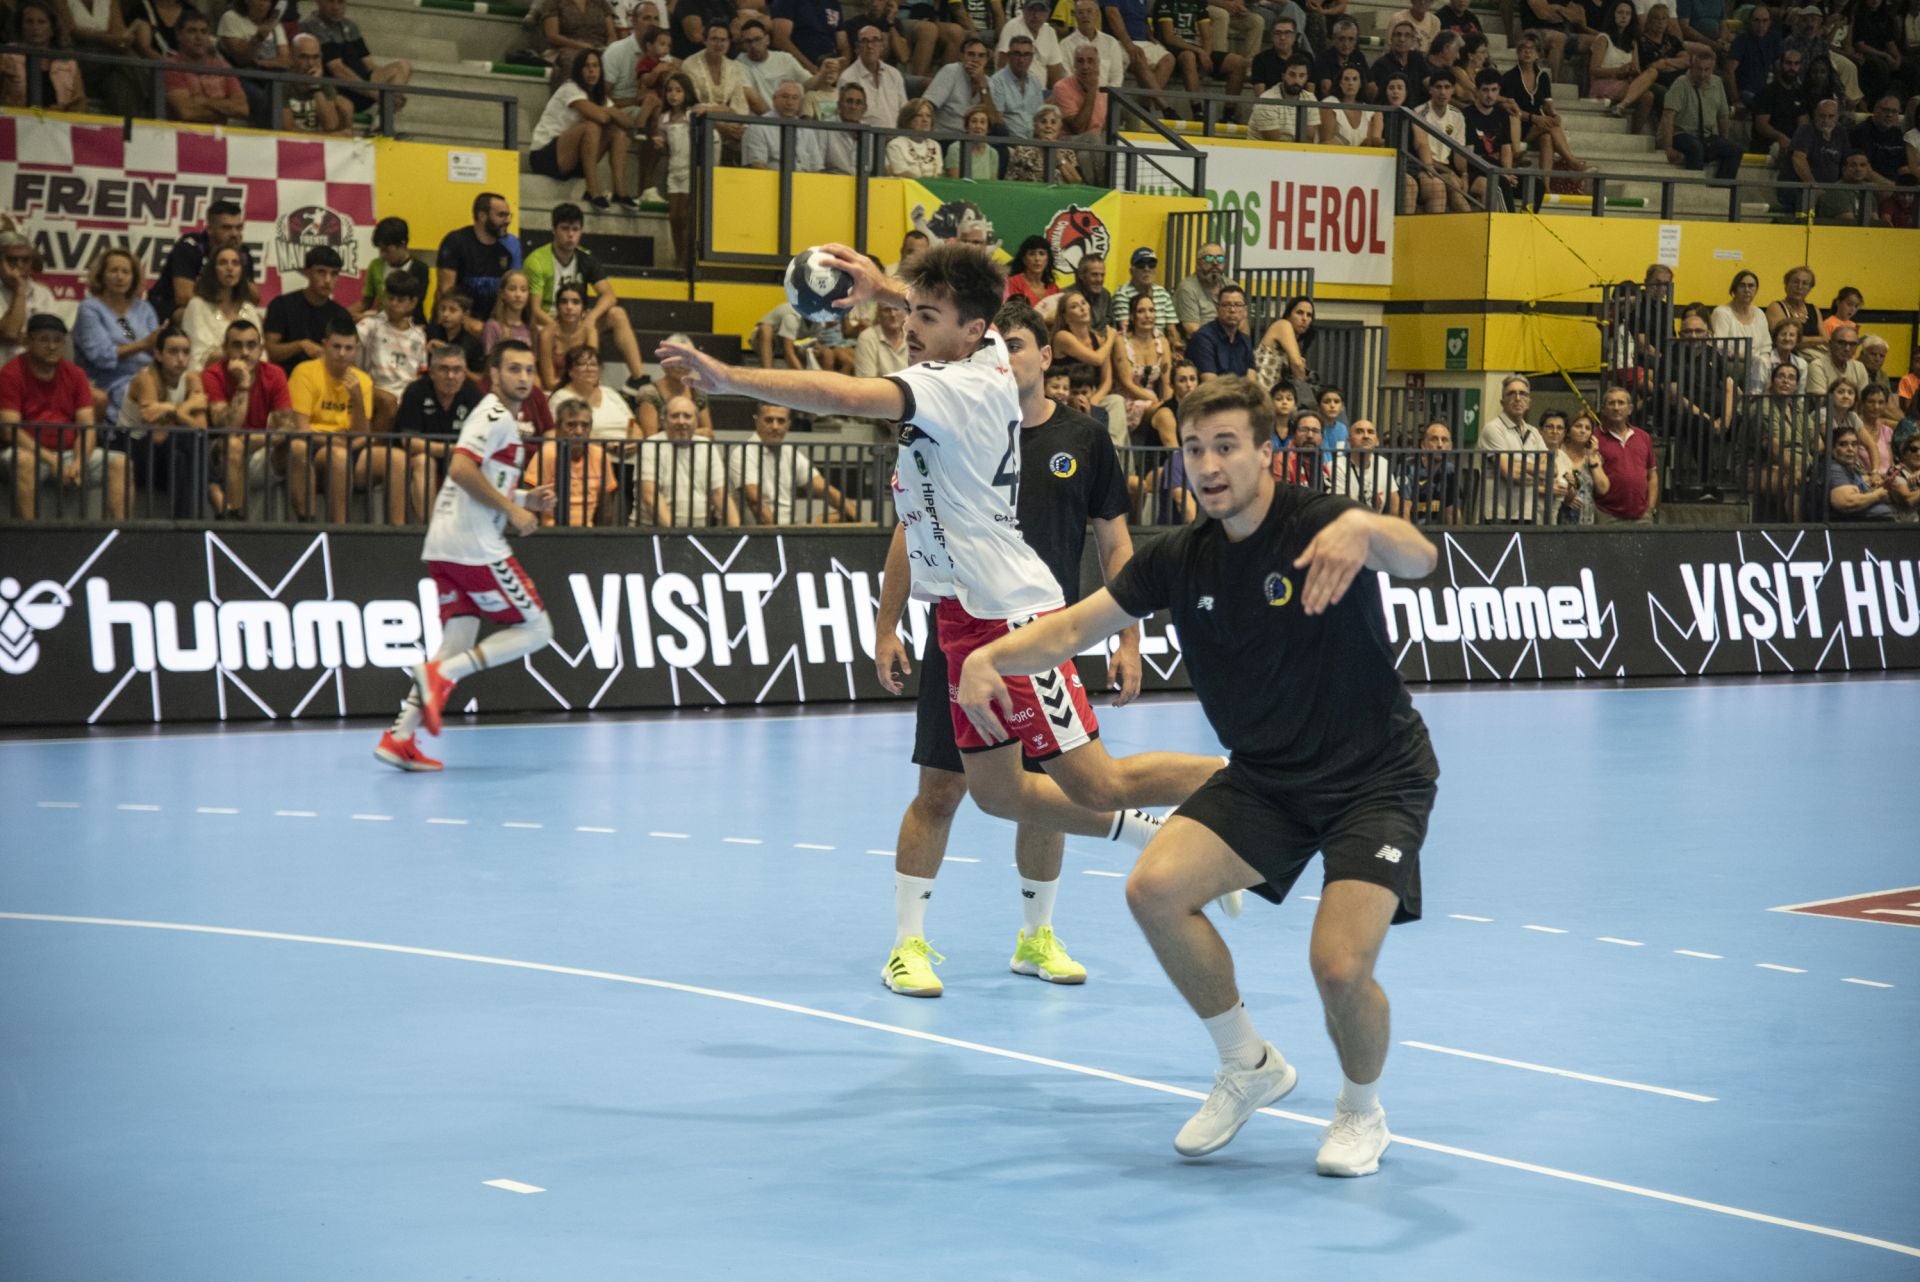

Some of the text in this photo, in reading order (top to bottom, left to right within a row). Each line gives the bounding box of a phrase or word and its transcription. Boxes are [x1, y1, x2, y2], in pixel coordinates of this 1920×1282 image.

[1269, 180, 1385, 254] HEROL
[992, 420, 1020, 507] 4
[87, 577, 443, 672] hummel
[569, 571, 774, 668] VISIT
[1377, 567, 1602, 643] hummel
[1680, 562, 1825, 642] VISIT
